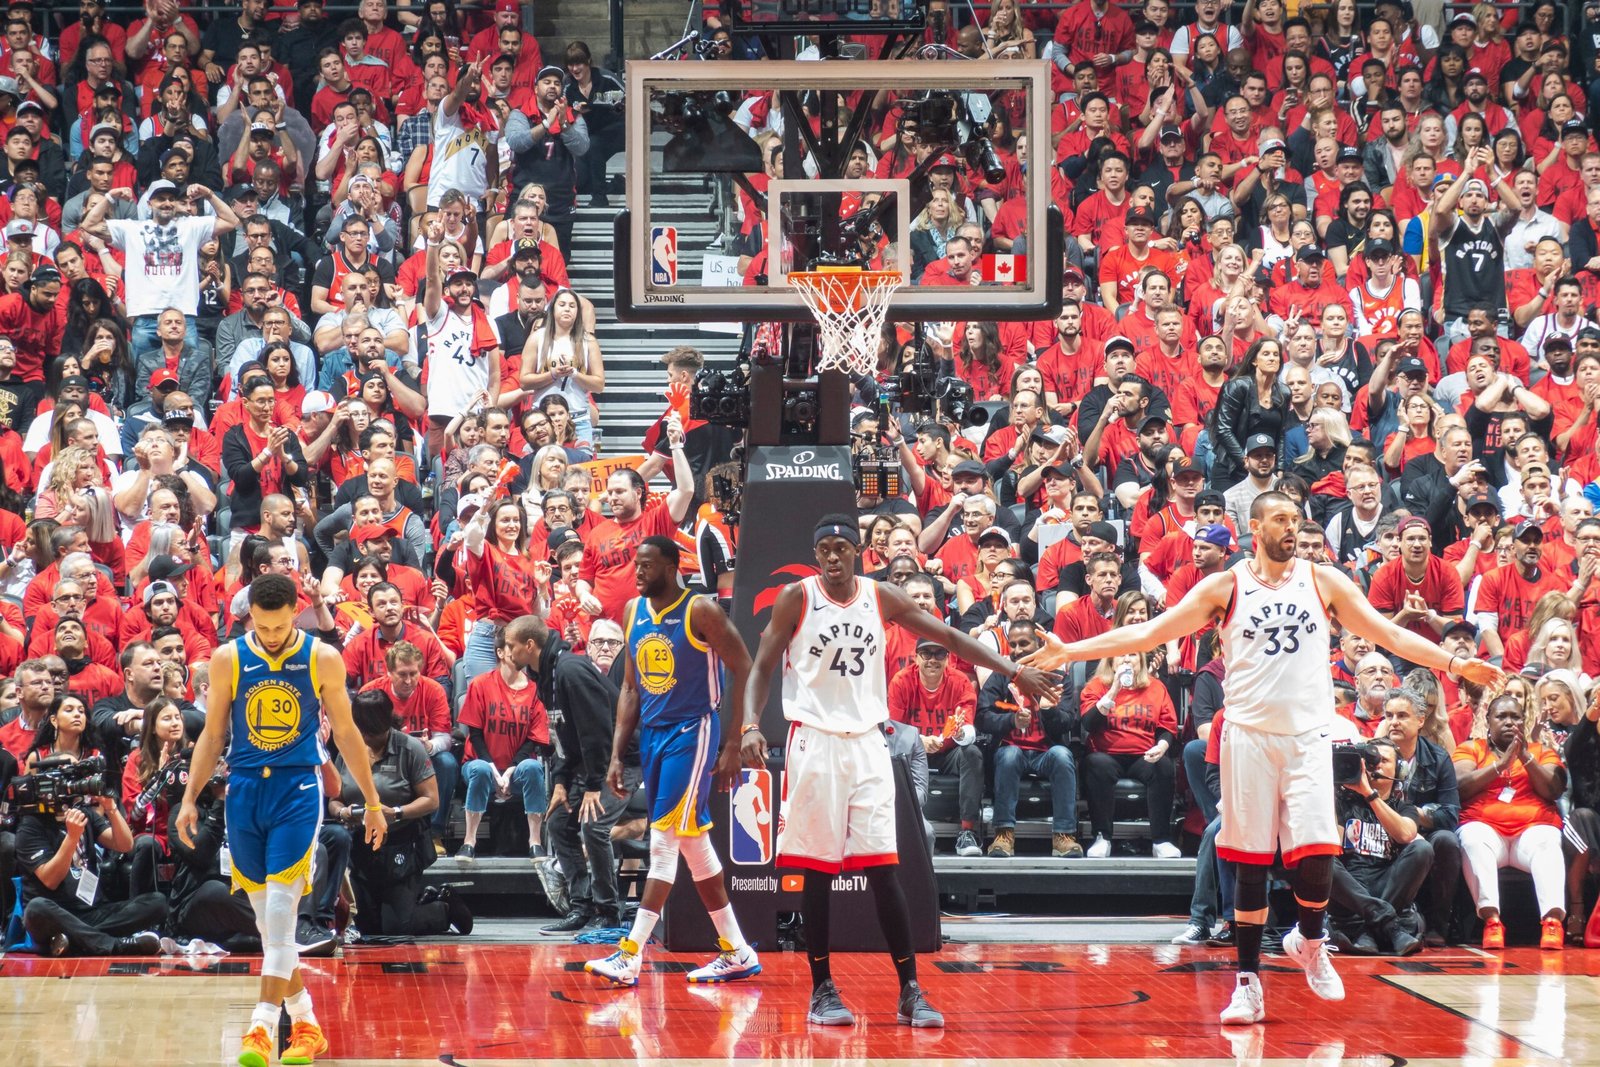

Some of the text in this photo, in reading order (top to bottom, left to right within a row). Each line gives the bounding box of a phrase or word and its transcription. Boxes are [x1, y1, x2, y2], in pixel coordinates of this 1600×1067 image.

[456, 132, 486, 148] NORT
[470, 148, 480, 166] 7
[545, 142, 554, 160] 7
[1456, 239, 1498, 260] RAPTORS
[144, 266, 181, 276] NORTH
[710, 260, 723, 273] US
[1472, 254, 1484, 272] 7
[654, 272, 668, 282] NBA
[203, 290, 217, 305] 12
[644, 294, 685, 304] SPALDING
[1381, 320, 1392, 334] 2
[444, 330, 470, 348] RAPT
[1136, 335, 1150, 345] WE
[1056, 366, 1094, 385] WE THE
[1332, 366, 1359, 388] TORS
[1057, 382, 1087, 400] NORT
[766, 463, 841, 480] SPALDING
[600, 528, 644, 552] WE THE
[494, 562, 508, 576] WE
[952, 565, 968, 576] WE
[1243, 603, 1317, 640] RAPTORS
[635, 632, 674, 650] GOLDEN STATE
[809, 623, 877, 658] RAPTORS
[1264, 625, 1300, 656] 33
[654, 649, 668, 662] 23
[830, 648, 864, 676] 43
[368, 660, 384, 673] WE
[244, 680, 302, 698] GOLDEN STATE
[640, 678, 678, 695] WARRIORS
[272, 700, 292, 714] 30
[489, 702, 505, 717] WE
[1124, 704, 1153, 718] THE
[488, 719, 528, 735] NORT
[247, 730, 300, 752] WARRIORS
[1362, 822, 1380, 838] NBA
[732, 876, 778, 893] Presented by
[832, 876, 868, 891] ubeTV
